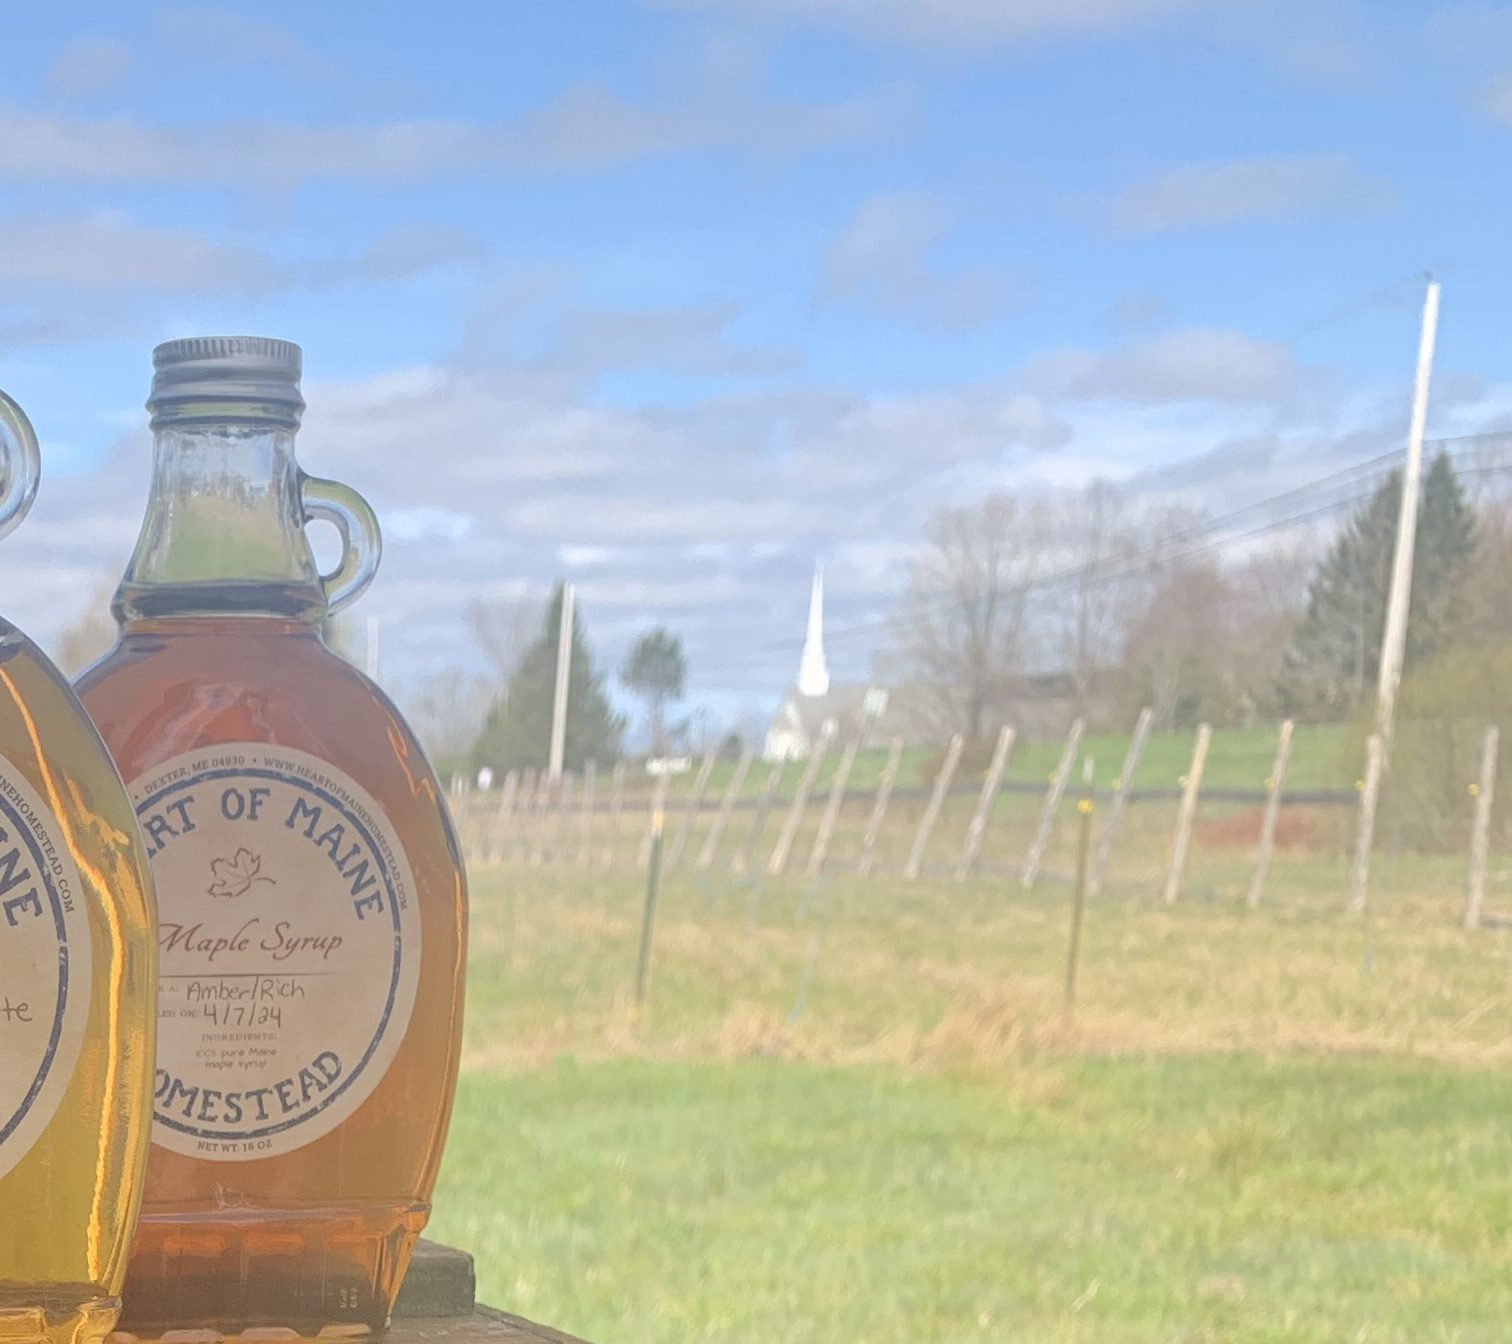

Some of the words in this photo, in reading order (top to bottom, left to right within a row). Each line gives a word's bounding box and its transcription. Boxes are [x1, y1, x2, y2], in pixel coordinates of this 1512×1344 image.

[220, 787, 271, 821] OF
[284, 796, 384, 920] MAINE
[159, 917, 259, 961] Maple
[259, 921, 342, 960] Syrup
[154, 1049, 341, 1123] OMESTEAD
